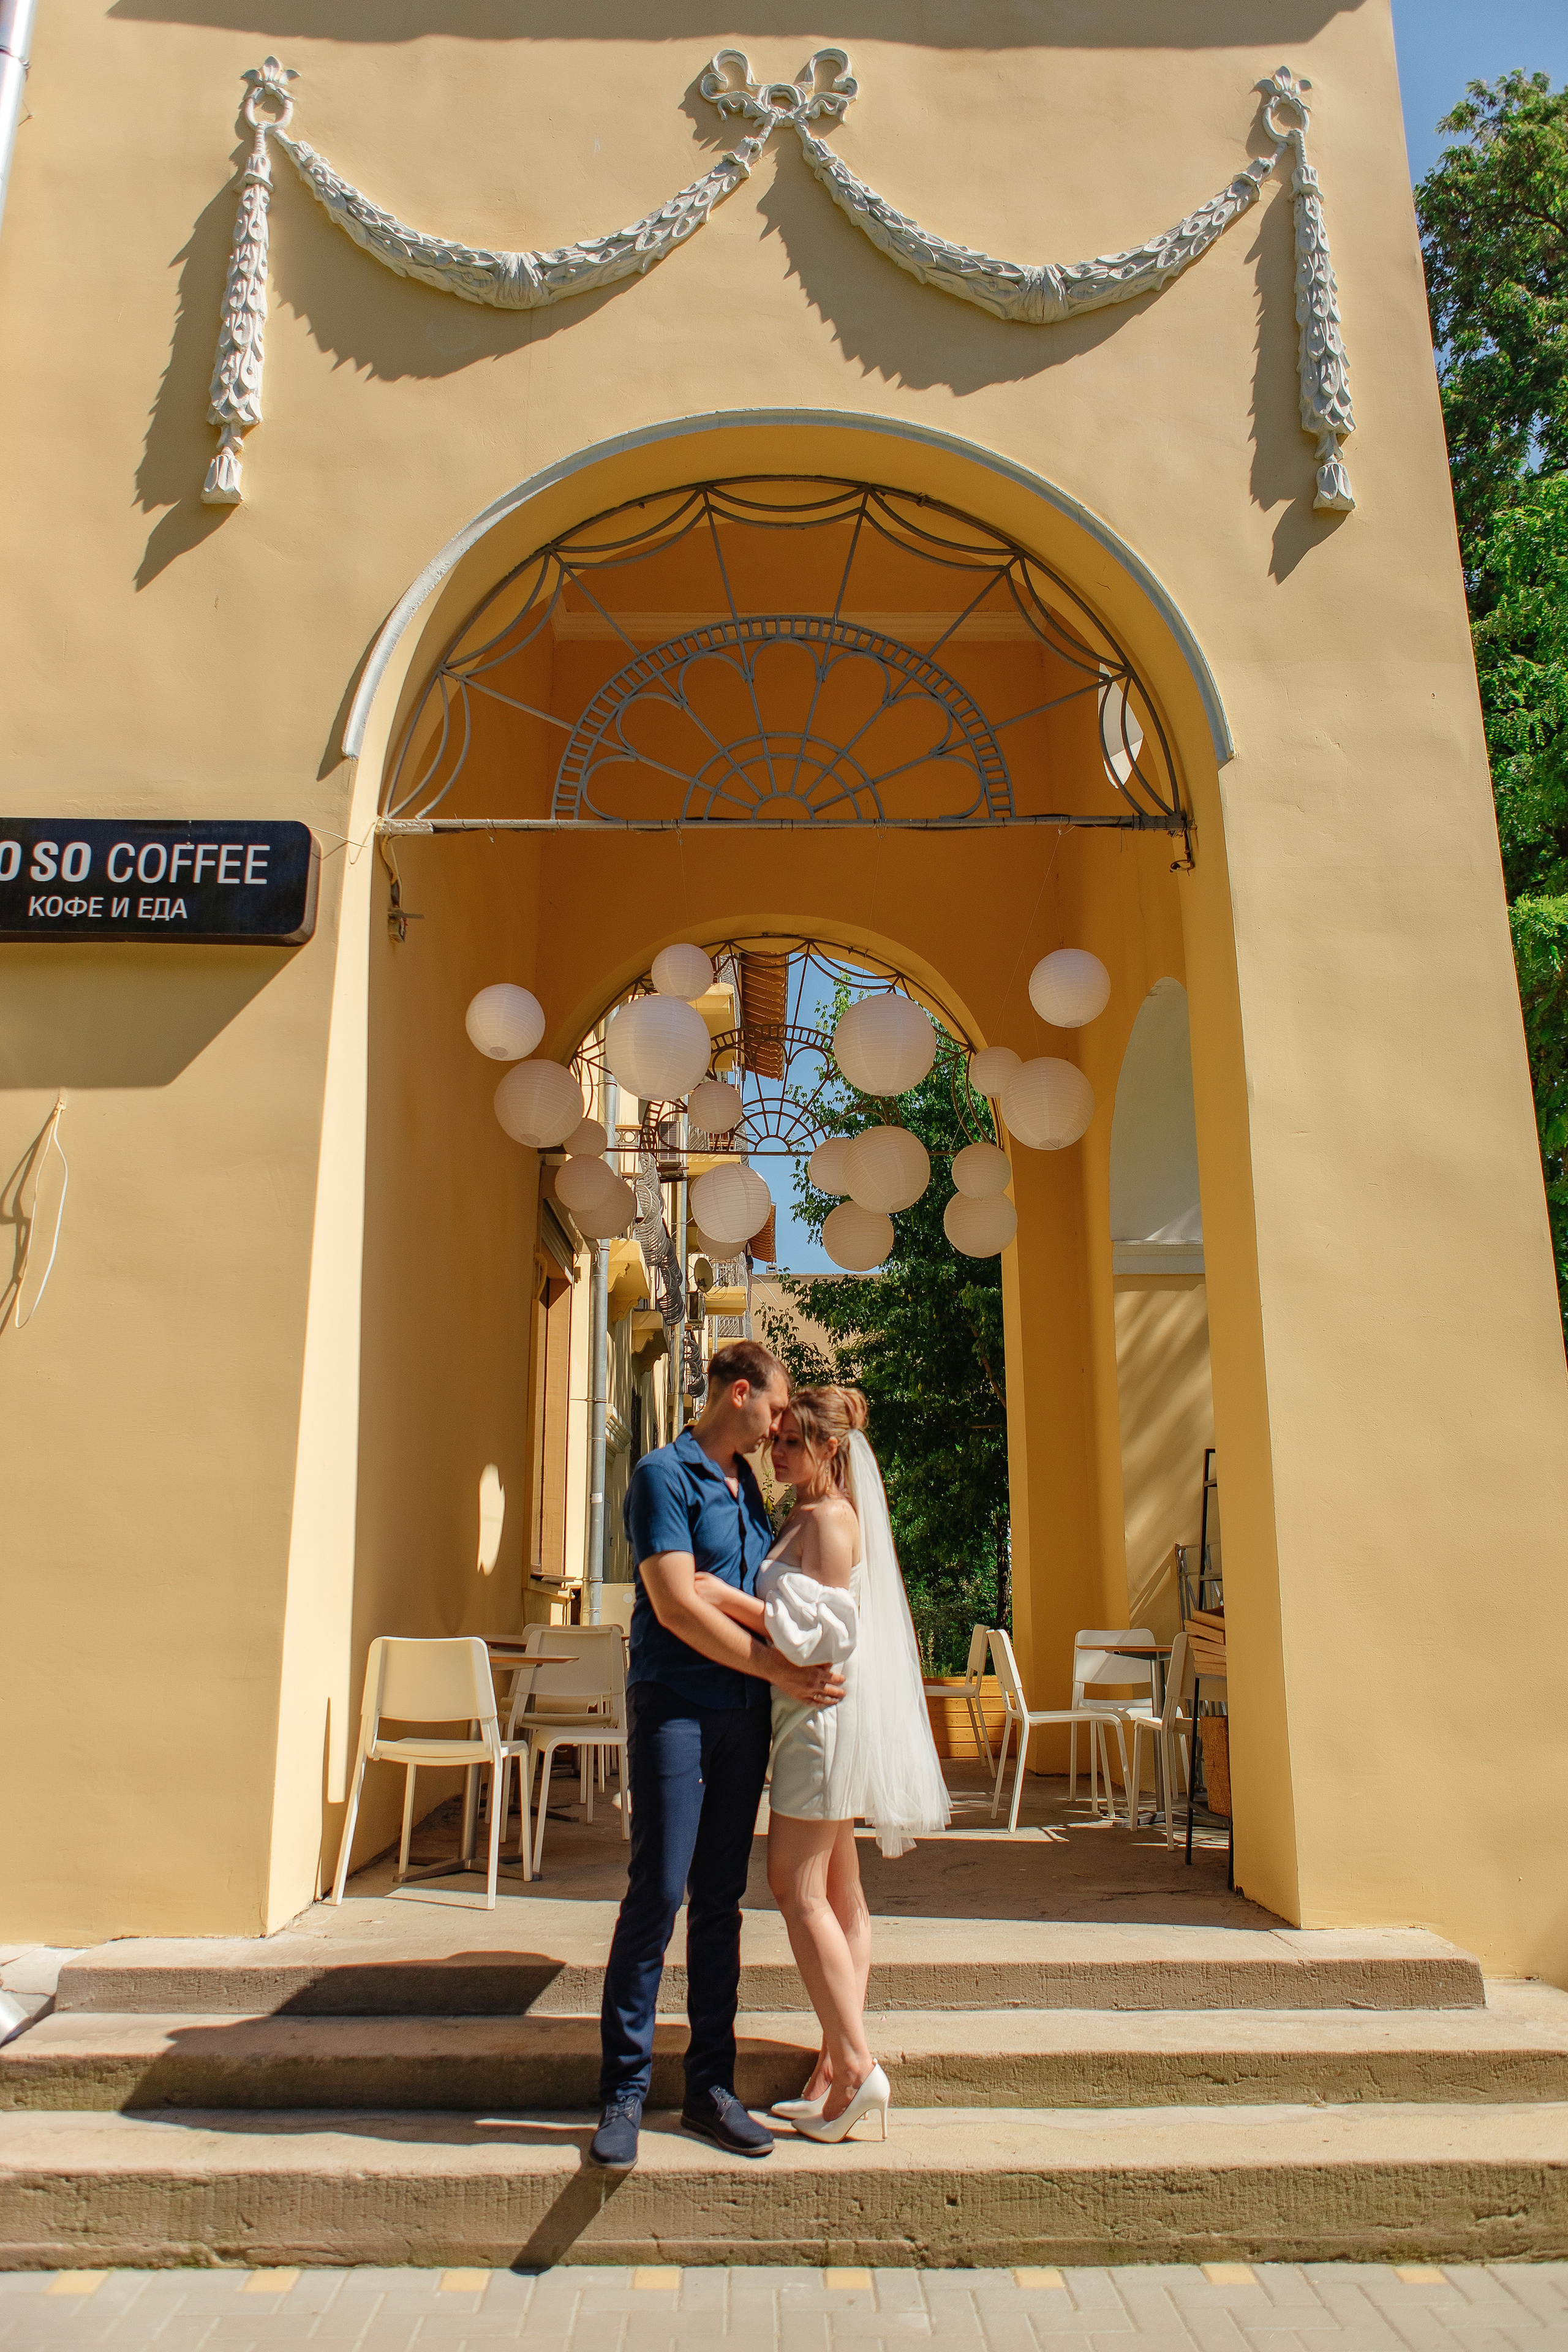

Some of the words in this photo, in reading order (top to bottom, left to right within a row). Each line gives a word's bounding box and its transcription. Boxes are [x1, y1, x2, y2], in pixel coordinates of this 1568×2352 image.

[29, 841, 92, 882] SO
[107, 842, 271, 884] COFFEE
[28, 896, 104, 918] КОФЕ
[111, 897, 130, 918] И
[137, 897, 187, 921] ЕДА
